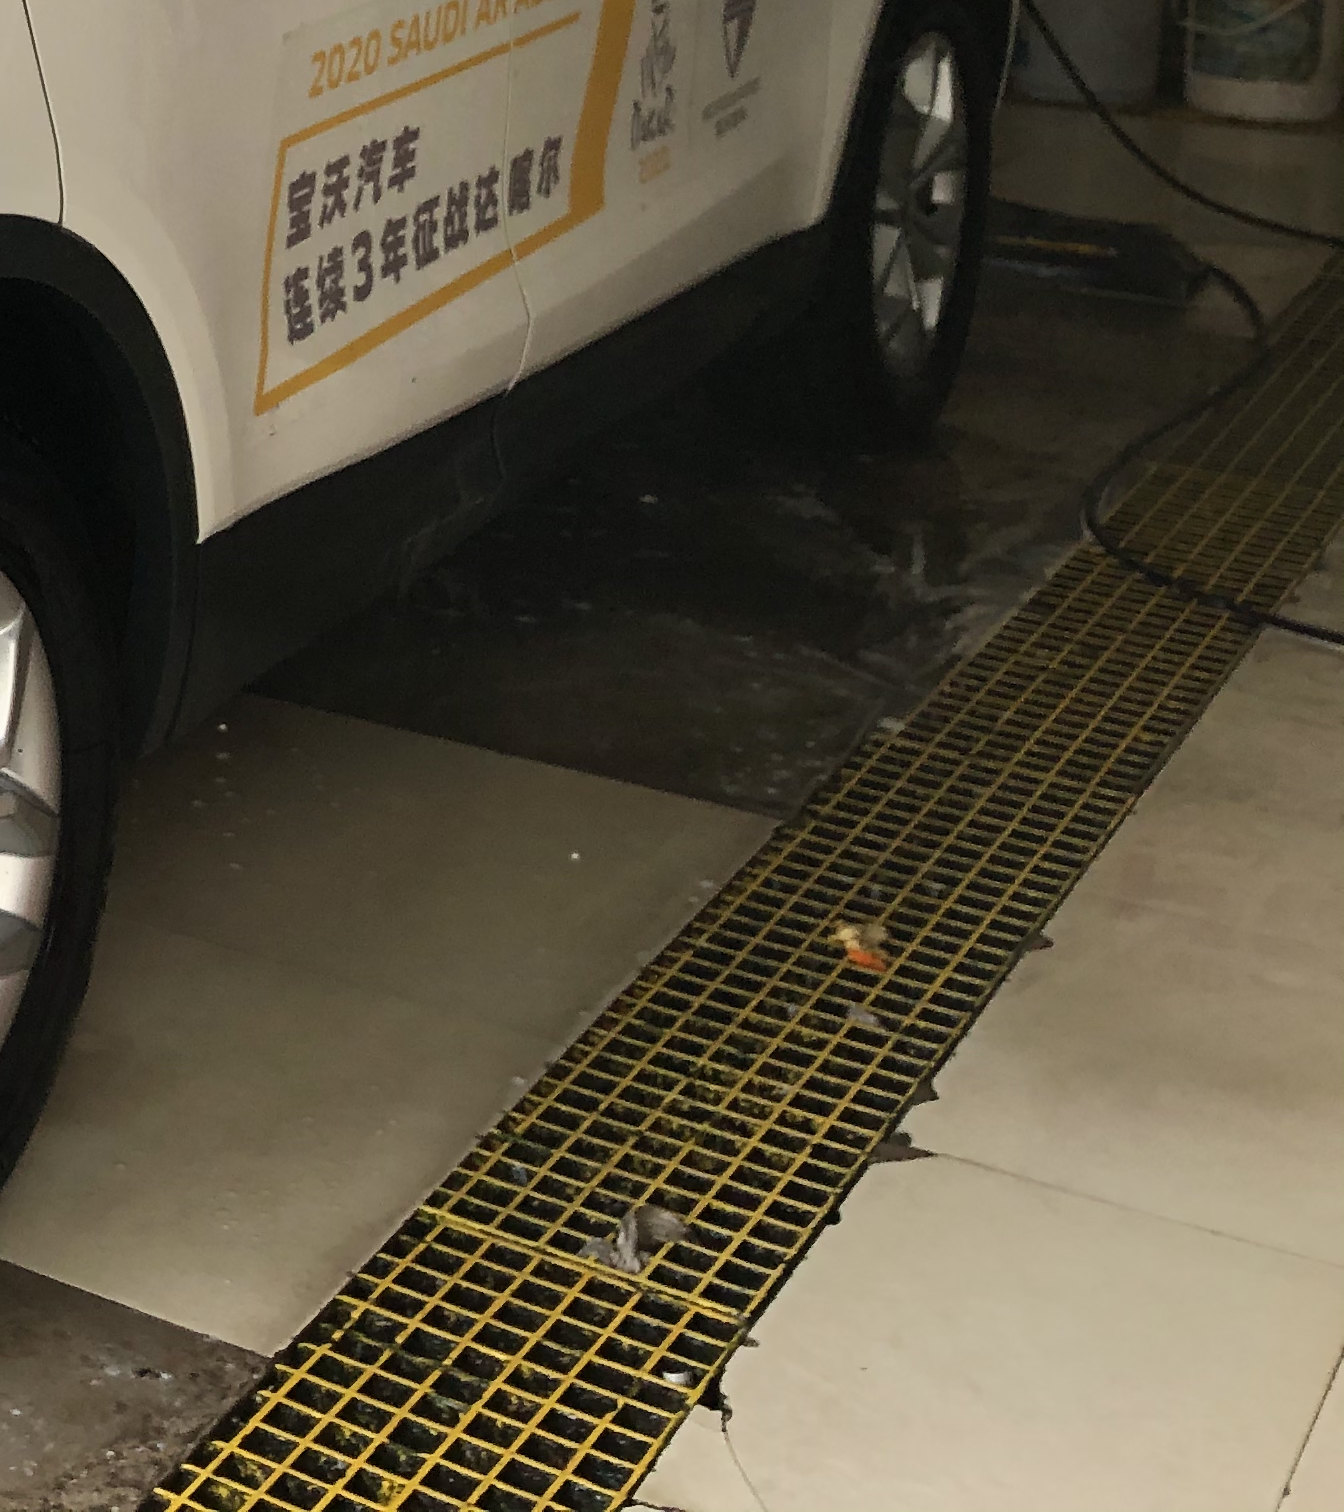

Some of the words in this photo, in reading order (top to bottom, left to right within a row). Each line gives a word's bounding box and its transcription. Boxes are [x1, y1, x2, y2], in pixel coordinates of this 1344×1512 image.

[308, 28, 382, 99] 2020
[283, 134, 564, 345] 连续3年征战达喀尔
[286, 125, 421, 249] 宝沃汽车
